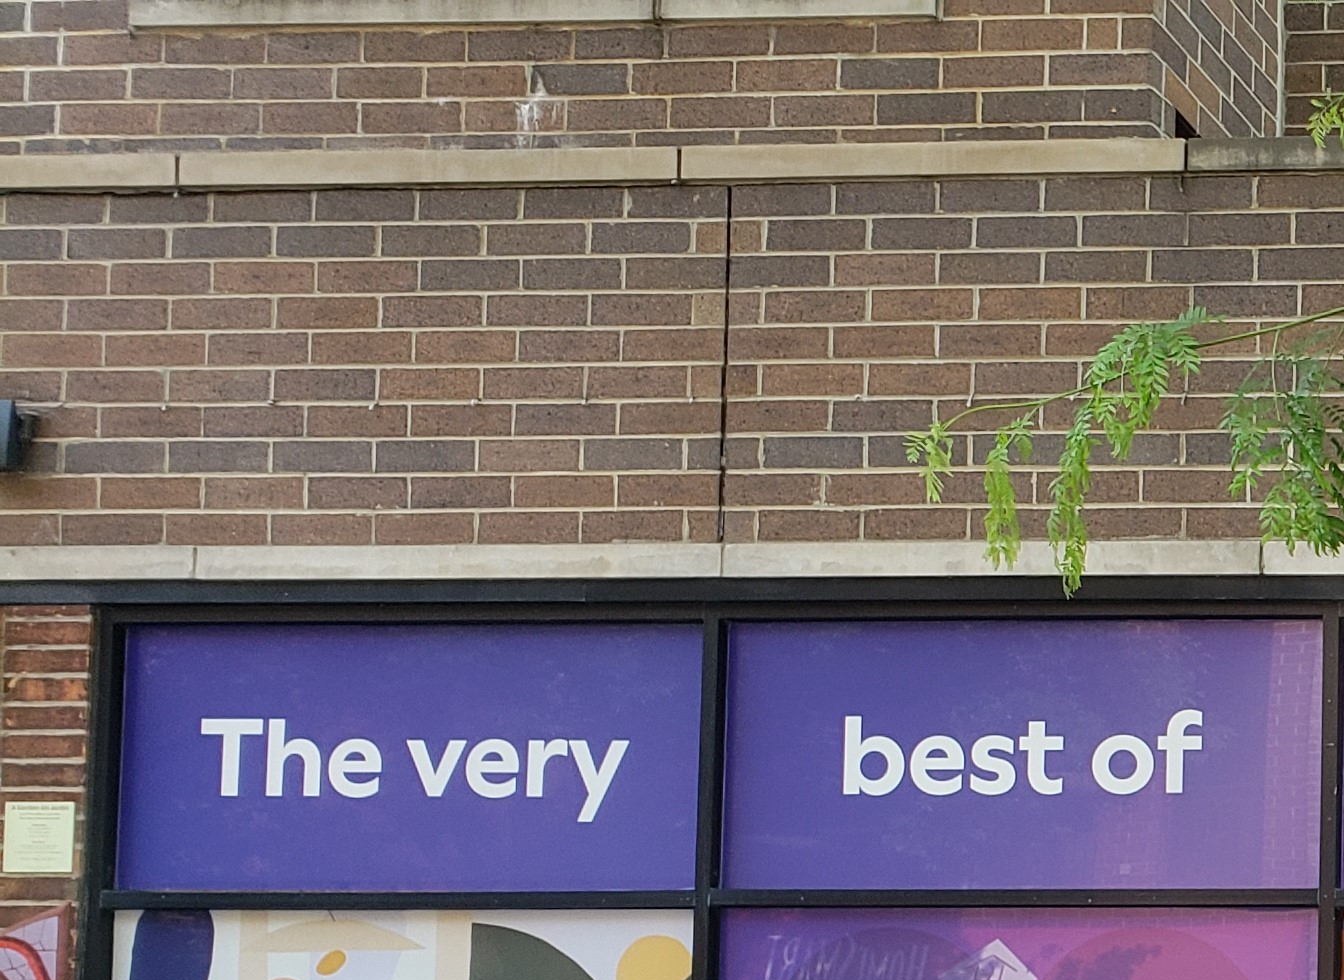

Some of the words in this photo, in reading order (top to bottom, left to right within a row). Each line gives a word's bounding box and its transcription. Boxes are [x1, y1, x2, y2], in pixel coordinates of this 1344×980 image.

[201, 719, 382, 798] The
[407, 739, 629, 823] very
[843, 716, 1064, 795] best
[1092, 710, 1203, 795] of
